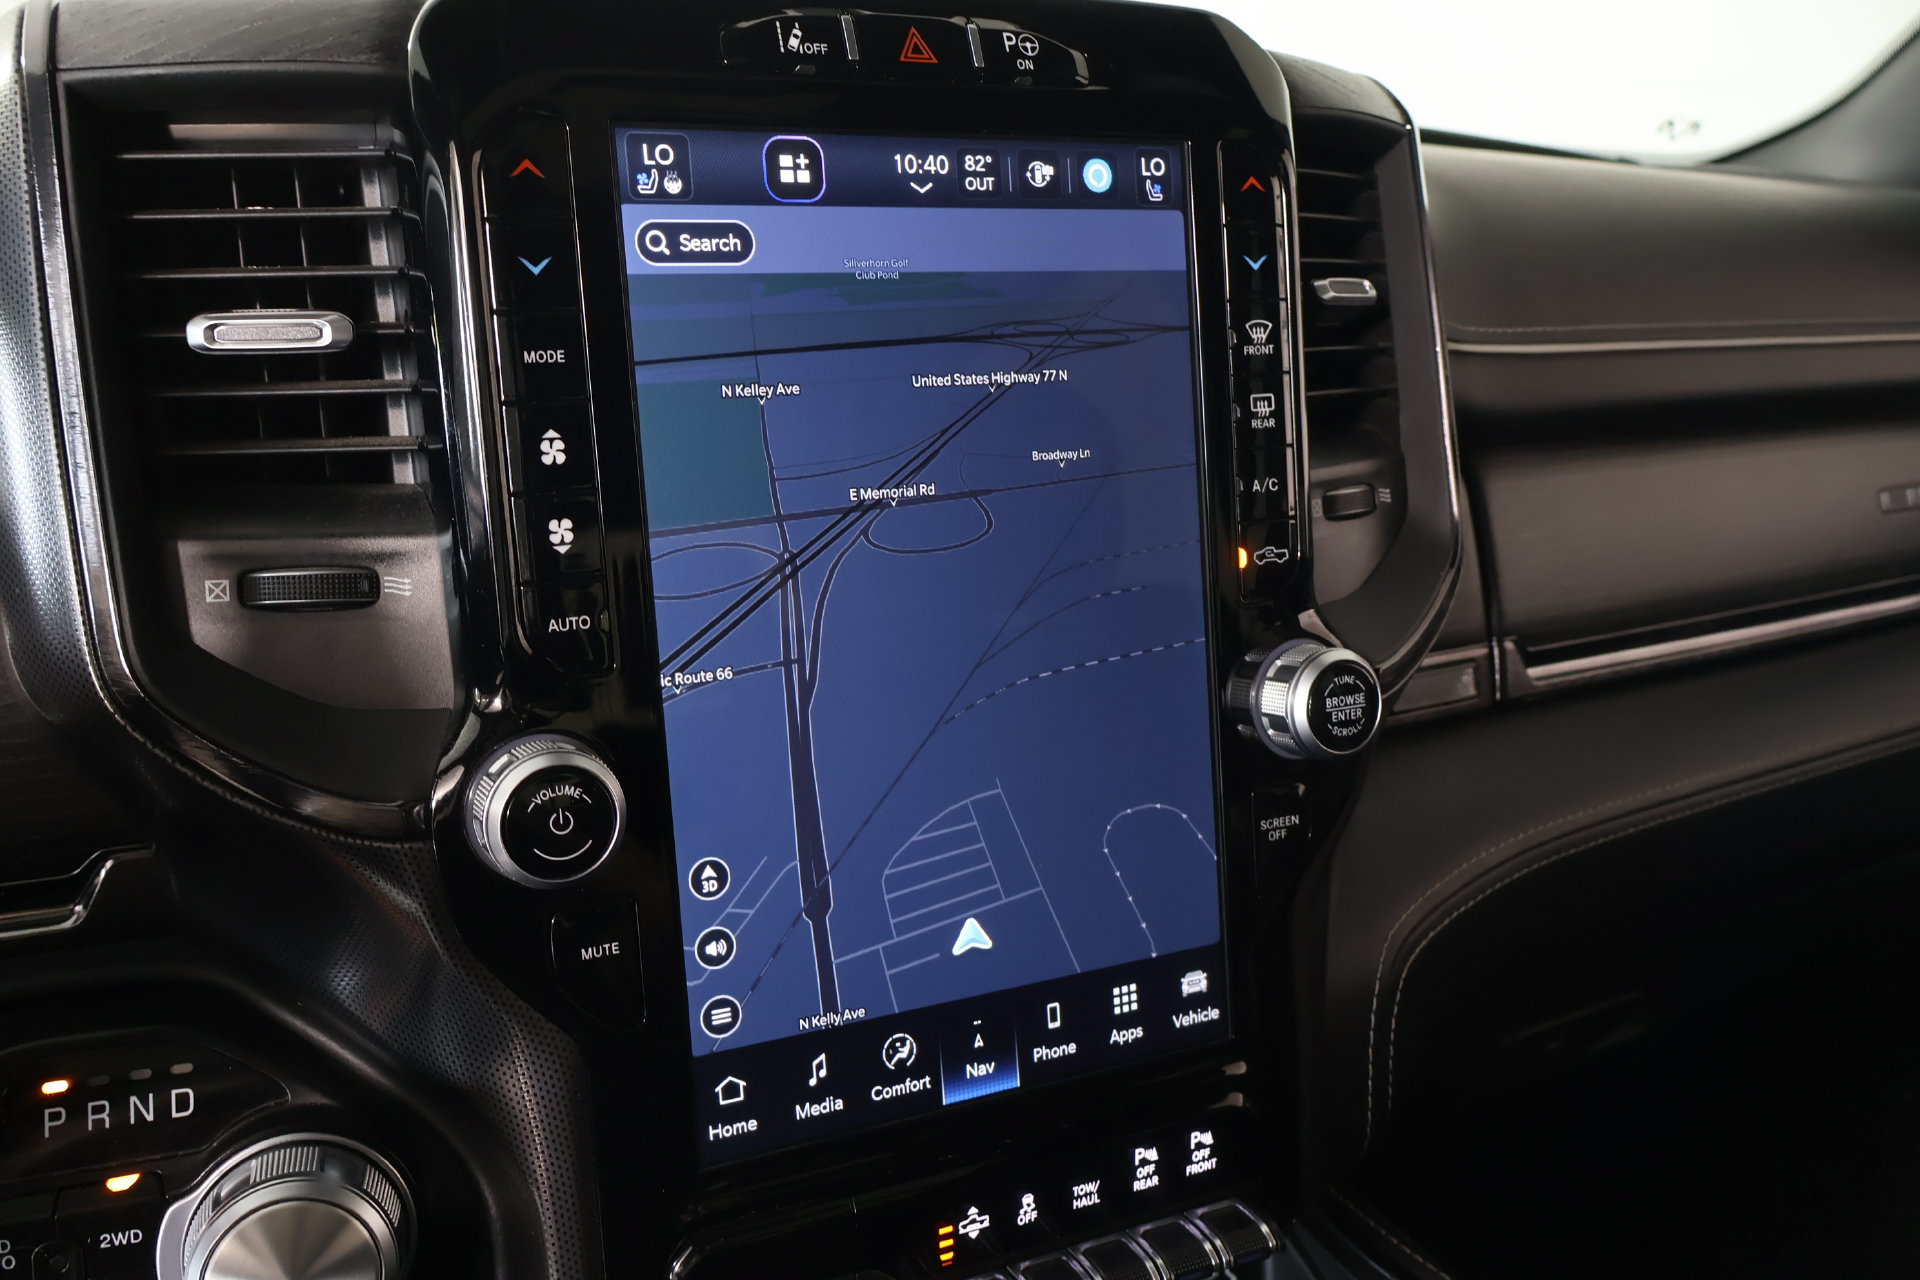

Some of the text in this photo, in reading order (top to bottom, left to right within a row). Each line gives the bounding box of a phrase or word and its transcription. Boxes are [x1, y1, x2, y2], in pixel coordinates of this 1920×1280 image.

[803, 42, 828, 55] OFF
[1003, 32, 1016, 53] P
[1016, 59, 1034, 71] ON
[642, 143, 675, 166] LO
[894, 153, 949, 175] 10:40
[964, 154, 993, 173] 82°
[1140, 156, 1165, 177] LO
[965, 176, 995, 192] OUT
[679, 233, 742, 252] Search
[891, 258, 909, 268] Golf
[855, 270, 900, 280] Club Pond
[523, 349, 566, 364] MODE
[1243, 344, 1275, 356] FRONT
[911, 369, 1068, 389] United States Highway 77 N
[721, 382, 801, 400] N Kelley Ave
[1251, 418, 1276, 429] REAR
[1032, 448, 1091, 463] Broadway Ln
[849, 482, 936, 501] E Memorial Rd
[1252, 477, 1279, 492] A/C
[548, 615, 591, 632] AUTO
[674, 670, 714, 686] Route
[715, 666, 733, 681] 66
[1333, 675, 1356, 686] TUNE
[1325, 692, 1366, 708] BROWSE
[1331, 708, 1363, 722] ENTER
[1331, 722, 1363, 737] SCROLL
[531, 785, 583, 805] VOLUME
[1260, 814, 1300, 831] SCREEN
[1268, 828, 1288, 842] OFF
[701, 879, 718, 893] 3D
[581, 942, 620, 960] MUTE
[799, 1007, 866, 1031] N Kelly Ave
[1172, 1006, 1220, 1028] Vehicle
[1109, 1025, 1144, 1045] Apps
[1033, 1042, 1077, 1063] Phone
[966, 1061, 996, 1079] Nav
[871, 1075, 932, 1101] Comfort
[44, 1088, 194, 1138] P R N D
[795, 1096, 844, 1121] Media
[708, 1118, 758, 1141] Home
[1191, 1147, 1210, 1162] OFF
[1136, 1164, 1156, 1179] OFF
[1186, 1158, 1217, 1176] FRONT
[1072, 1180, 1100, 1197] TOW/
[1133, 1176, 1159, 1192] REAR
[1072, 1193, 1101, 1210] HAUL
[1017, 1210, 1038, 1226] OFF
[99, 1229, 143, 1248] 2WD
